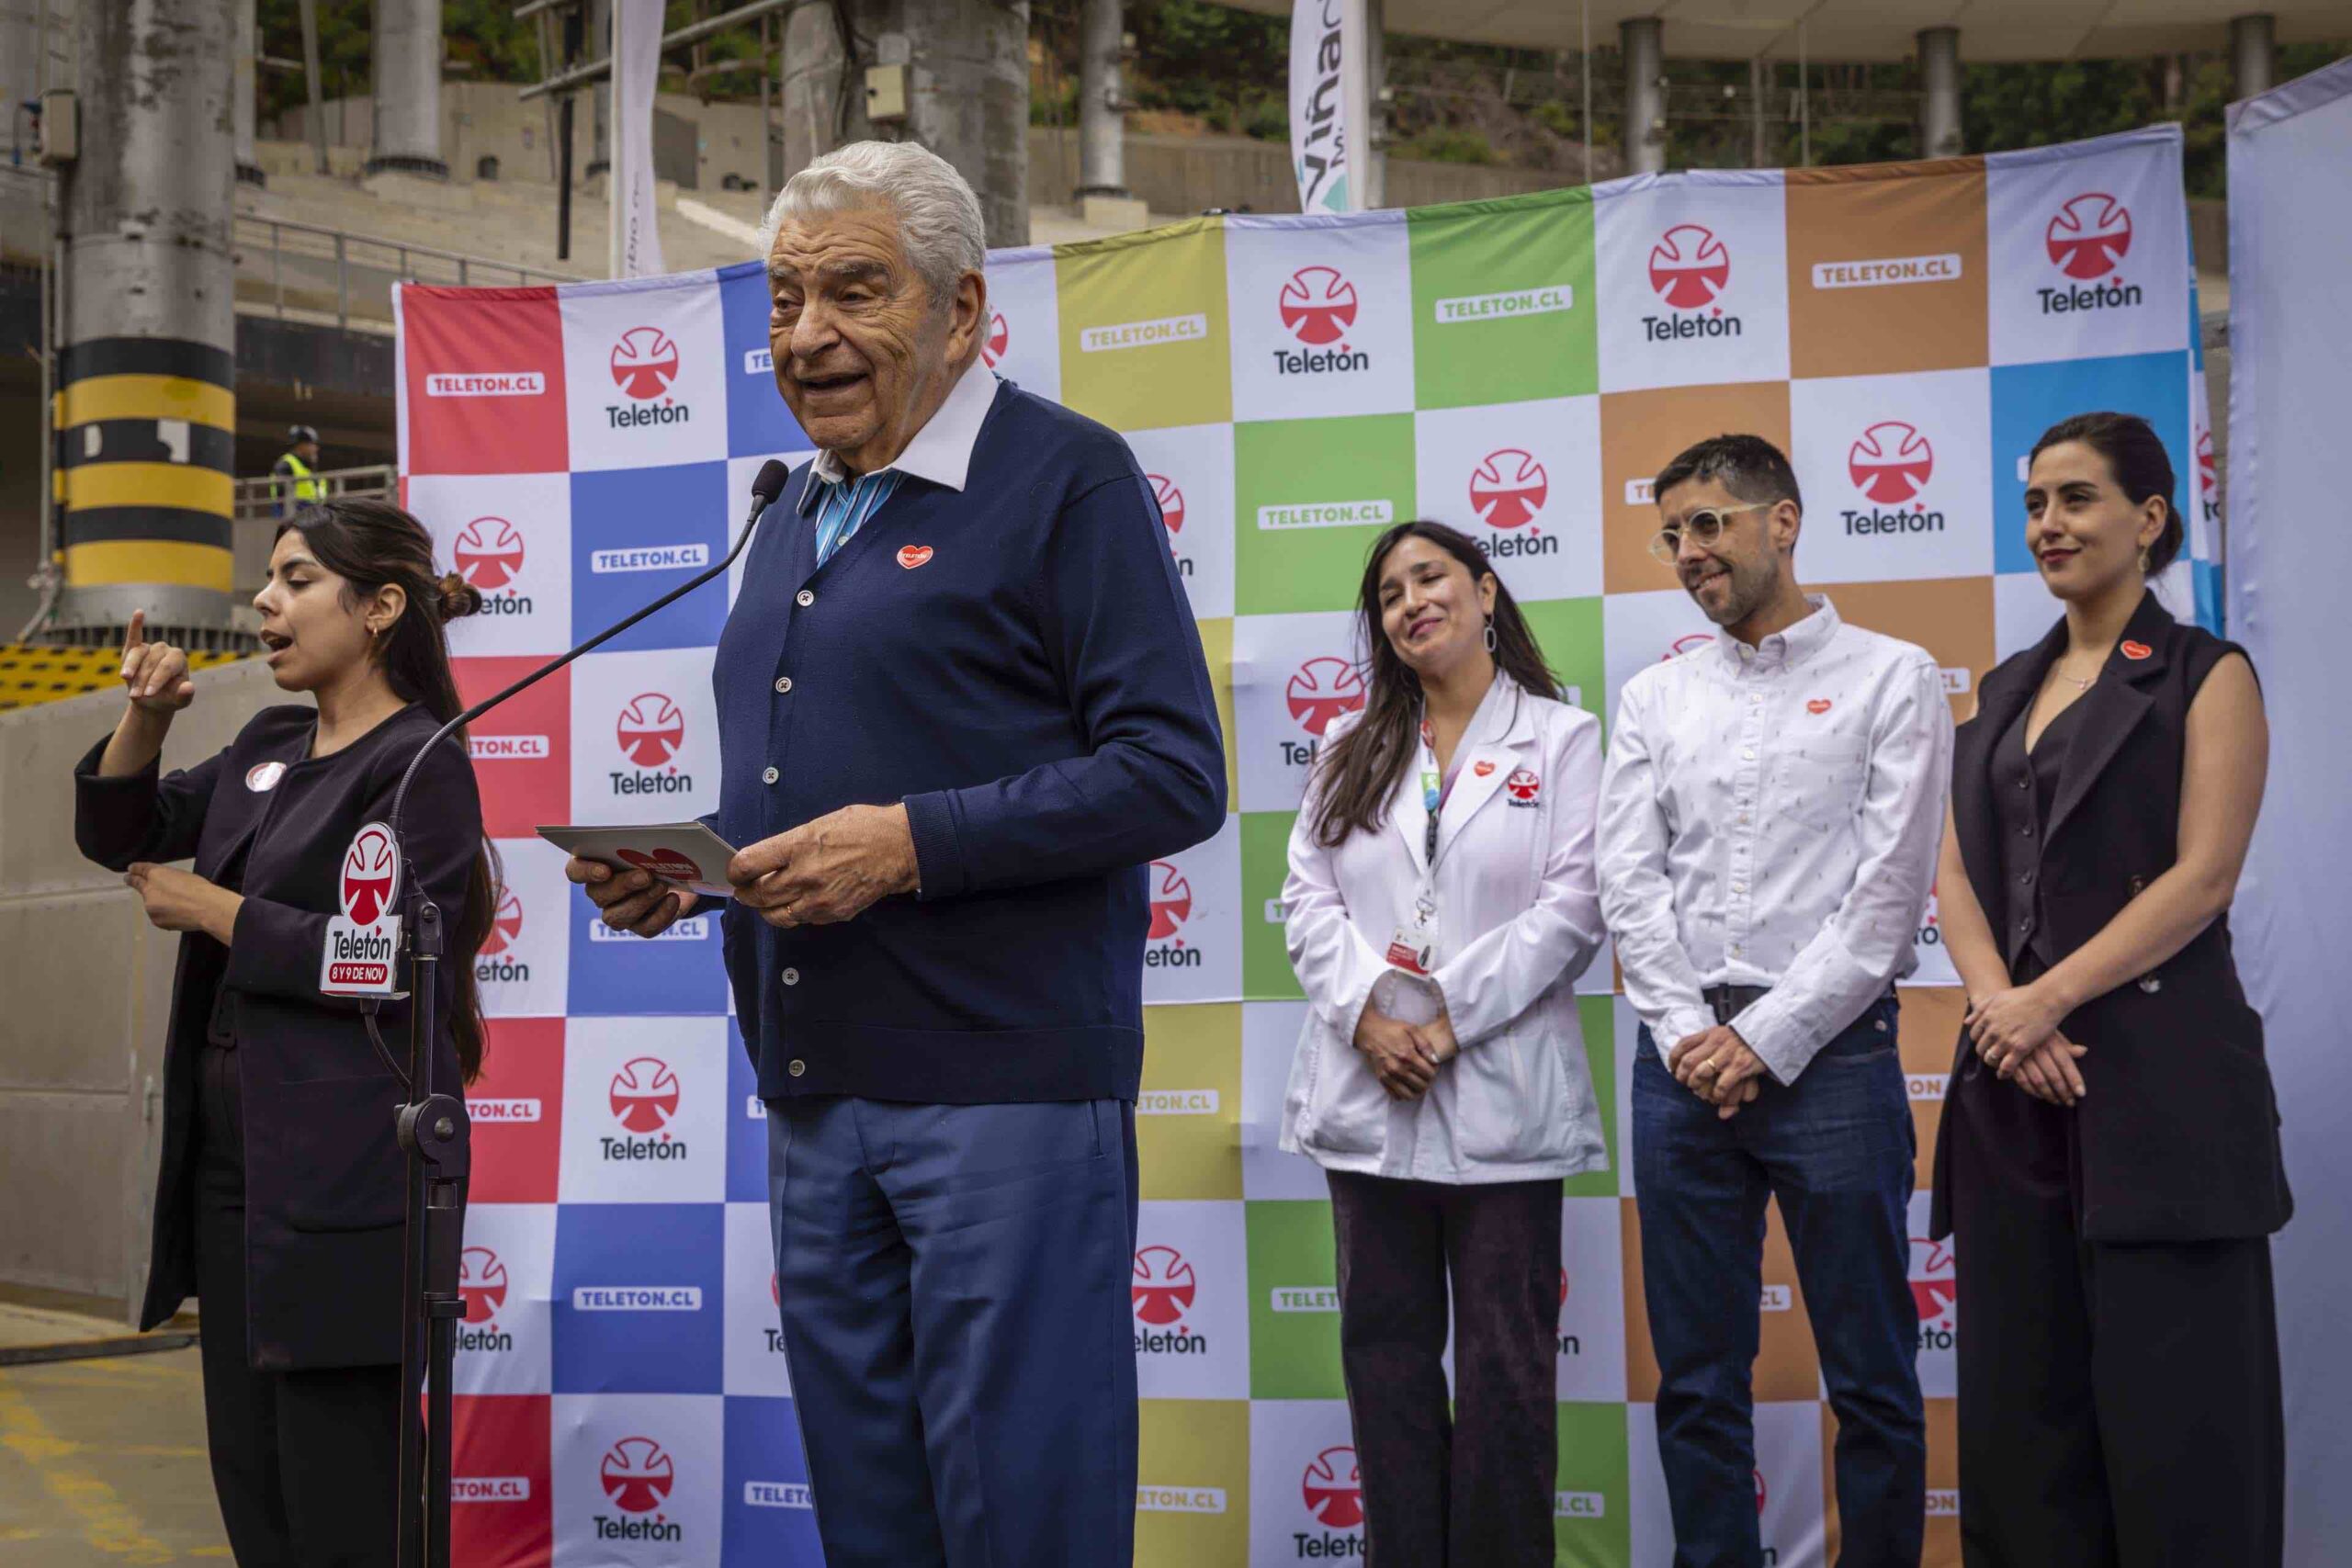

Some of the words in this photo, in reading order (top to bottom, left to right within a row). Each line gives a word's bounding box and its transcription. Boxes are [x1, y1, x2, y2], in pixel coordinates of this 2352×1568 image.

[1823, 260, 1951, 283] TELETON.CL
[1444, 292, 1563, 319] TELETON.CL
[2038, 276, 2142, 314] Teletón
[1090, 321, 1199, 346] TELETON.CL
[1643, 307, 1741, 342] Teletón
[1274, 344, 1369, 374] Teletón
[434, 377, 537, 392] TELETON.CL
[606, 399, 689, 428] Teletón
[1267, 506, 1383, 525] TELETON.CL
[1841, 502, 1944, 535] Teletón
[599, 547, 701, 567] TELETON.CL
[480, 589, 532, 615] etón
[610, 766, 691, 795] Teletón
[334, 925, 391, 959] Teletón
[1146, 939, 1201, 966] etón
[333, 967, 338, 980] 8
[339, 967, 345, 979] Y
[346, 967, 351, 980] 9
[353, 967, 364, 980] DE
[366, 967, 385, 980] NOV
[476, 956, 529, 981] etón
[470, 1103, 533, 1118] TON.CL
[601, 1133, 686, 1160] Teletón
[582, 1292, 693, 1306] TELETON.CL
[1134, 1325, 1205, 1354] eletón
[1137, 1492, 1217, 1507] ETON.CL
[594, 1514, 681, 1541] Teletón
